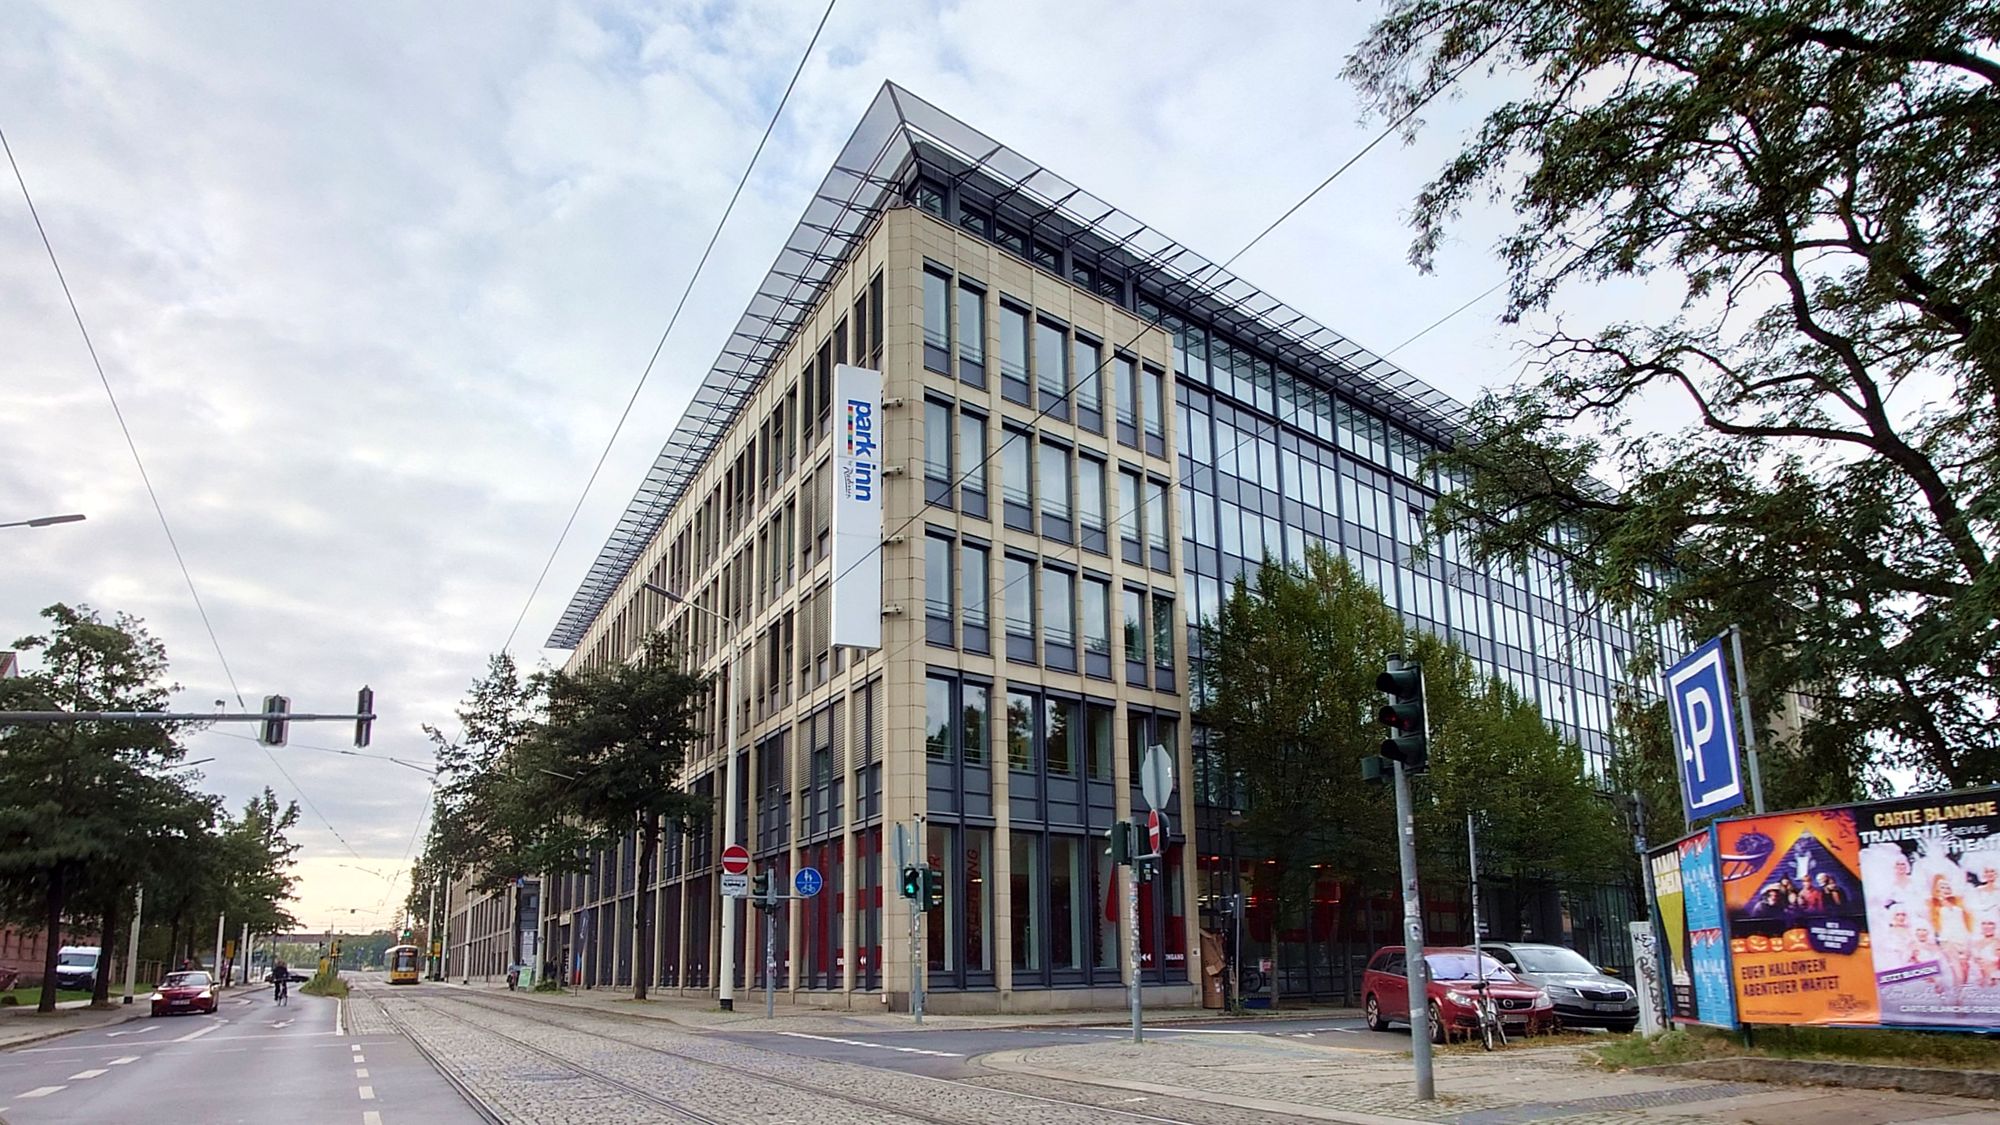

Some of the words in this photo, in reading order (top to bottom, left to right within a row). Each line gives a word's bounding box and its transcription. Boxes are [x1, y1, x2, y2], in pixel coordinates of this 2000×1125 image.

[847, 399, 877, 458] park
[855, 462, 877, 502] inn
[1685, 686, 1714, 783] P
[1873, 809, 1922, 827] CARTE
[1923, 800, 1998, 822] BLANCHE
[1858, 823, 1948, 844] TRAVESTIE
[1741, 965, 1765, 980] EUER
[1768, 958, 1827, 977] HALLOWEEN
[1743, 980, 1798, 996] ABENTEUER
[1799, 975, 1840, 992] WARTET
